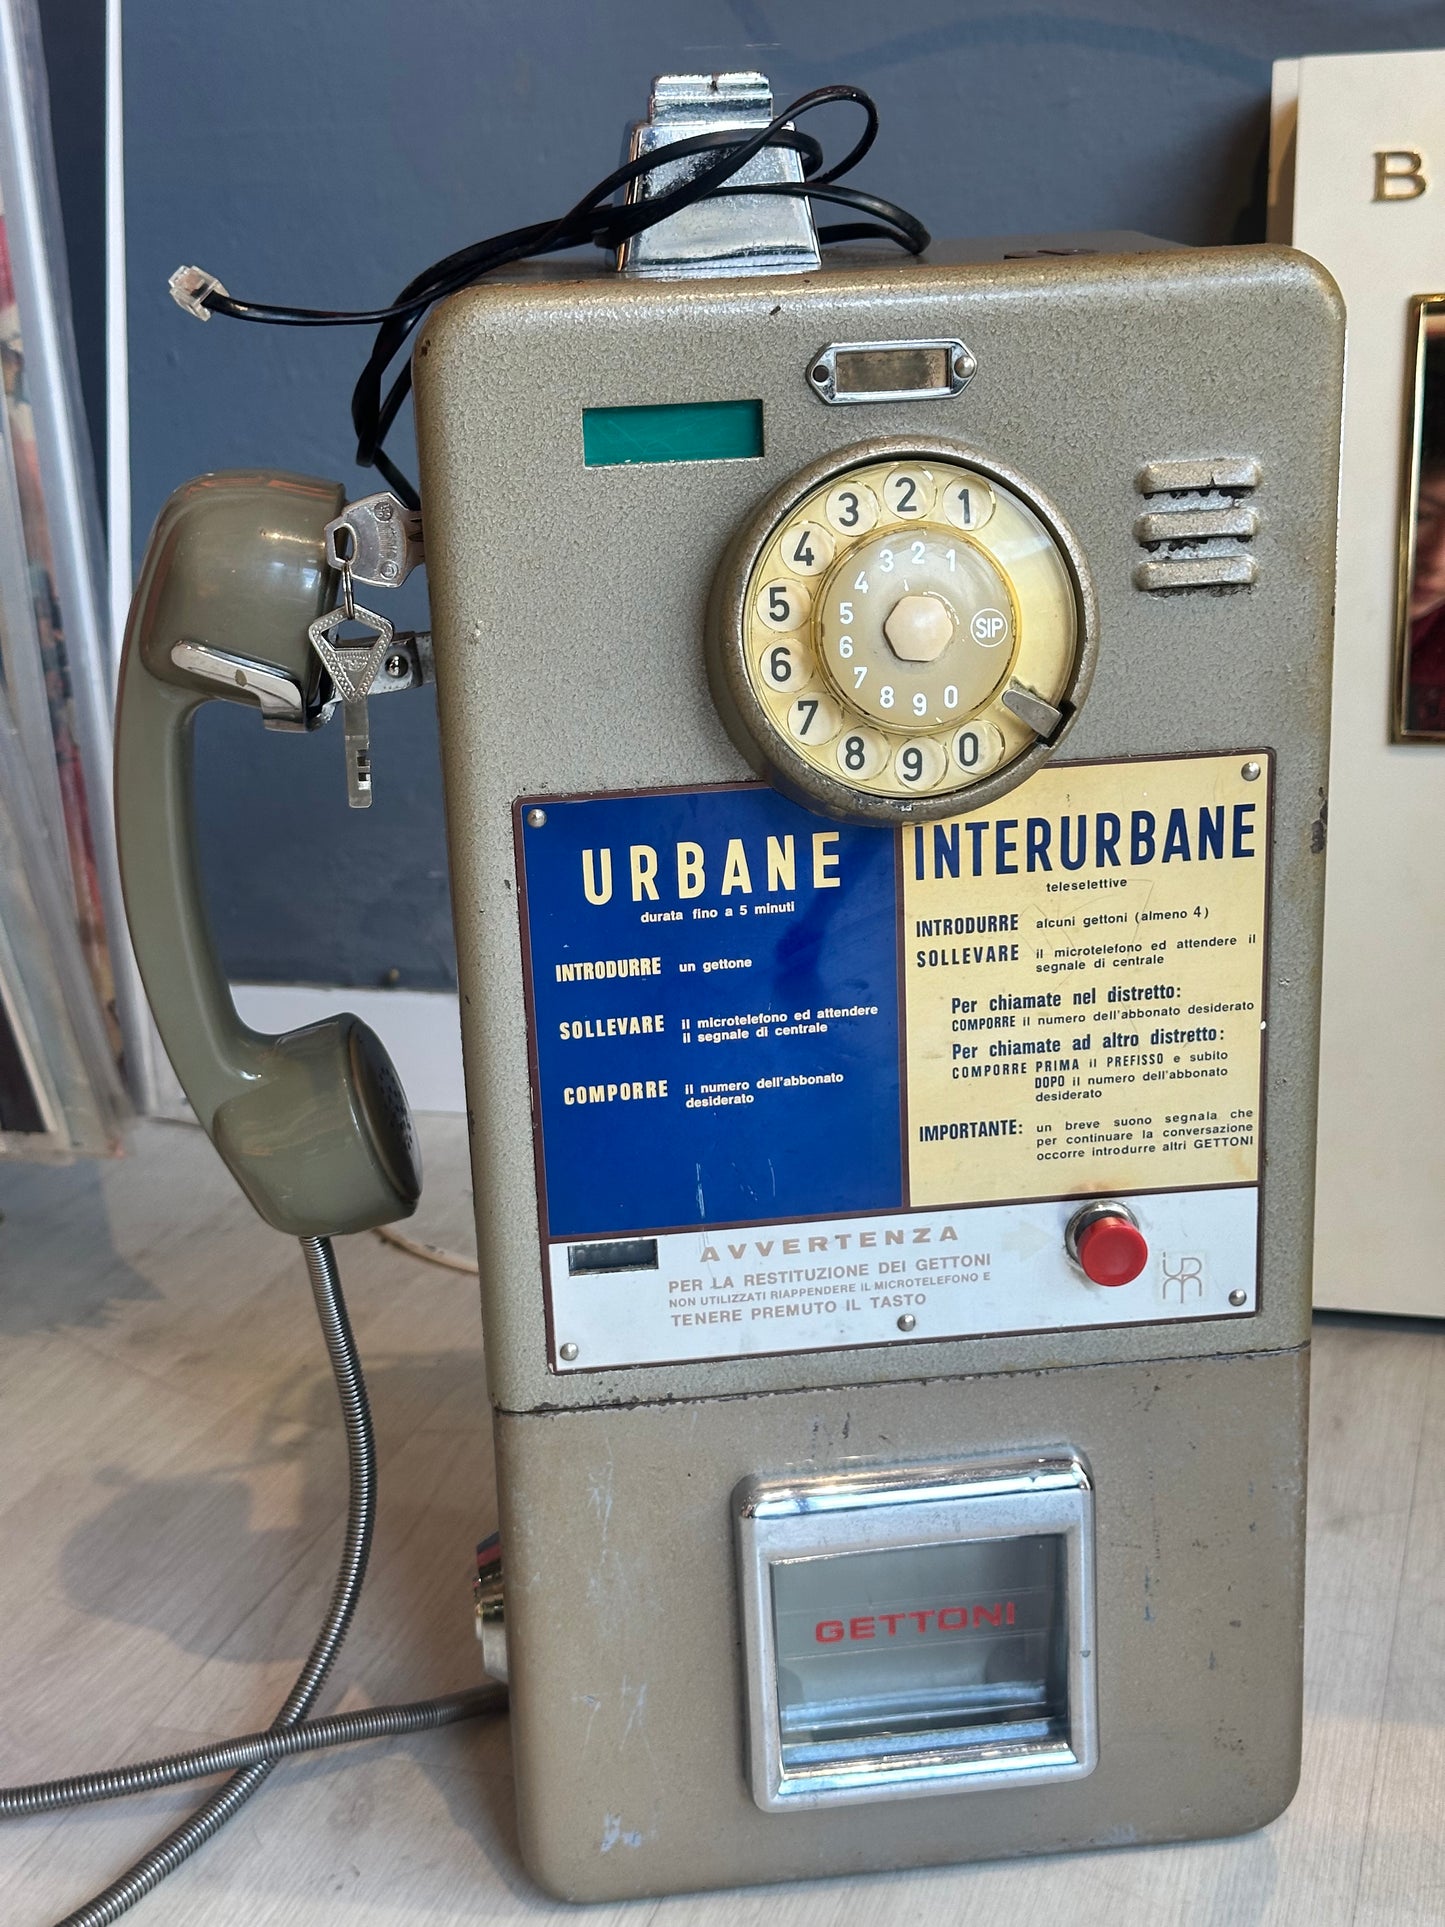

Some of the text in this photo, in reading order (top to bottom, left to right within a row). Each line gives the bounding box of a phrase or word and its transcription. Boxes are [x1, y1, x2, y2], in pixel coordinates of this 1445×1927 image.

[836, 492, 859, 527] 3
[895, 477, 917, 512] 2
[957, 488, 971, 524] 1
[793, 530, 815, 566] 4
[880, 549, 894, 573] 3
[911, 541, 925, 564] 2
[945, 549, 957, 572] 1
[854, 571, 869, 593] 4
[769, 587, 790, 622] 5
[839, 602, 853, 625] 5
[976, 618, 1003, 638] SIP
[839, 636, 853, 658] 6
[770, 647, 791, 682] 6
[853, 667, 867, 689] 7
[880, 685, 895, 708] 8
[913, 693, 927, 716] 9
[944, 685, 958, 707] 0
[797, 700, 818, 735] 7
[845, 736, 866, 771] 8
[902, 747, 923, 782] 9
[958, 732, 978, 767] 0
[914, 803, 1257, 881] INTERURBANE
[581, 831, 841, 906] URBANE
[1046, 877, 1128, 892] teleselettive
[640, 901, 795, 923] durata fino a 5 minuti
[916, 913, 1019, 937] INTRODURRE
[1036, 916, 1076, 929] alcuni
[1082, 911, 1128, 928] gettoni
[1135, 908, 1188, 925] (almeno
[916, 934, 1256, 968] SOLLEVARE il microtelefono ed attendere il
[1036, 953, 1165, 974] segnale di centrale
[555, 957, 753, 982] INTRODURRE un gettone
[951, 983, 1181, 1015] Per chiamate nel distretto:
[559, 1014, 665, 1041] SOLLEVARE
[697, 1010, 788, 1029] microtelefono
[793, 1009, 811, 1022] ed
[816, 1004, 878, 1019] attendere
[951, 1001, 1255, 1032] COMPORRE il numero dell'abbonato desiderato
[697, 1028, 750, 1044] segnale
[755, 1026, 769, 1039] di
[774, 1022, 828, 1036] centrale
[952, 1026, 1225, 1060] Per chiamate ad altro distretto:
[952, 1049, 1229, 1080] COMPORRE PRIMA il PREFISSO e subito
[1034, 1066, 1228, 1089] DOPO il numero dell'abbonato
[563, 1079, 668, 1106] COMPORRE
[700, 1080, 750, 1093] numero
[756, 1071, 844, 1090] dell'abbonato
[685, 1093, 754, 1109] desiderato
[1035, 1088, 1103, 1103] desiderato
[919, 1108, 1254, 1142] IMPORTANTE: un breve suono segnala che
[1036, 1122, 1254, 1148] per continuare la conversazione
[1036, 1136, 1254, 1161] occorre introdurre altri GETTONI
[700, 1226, 959, 1263] AVVERTENZA
[668, 1253, 992, 1294] PER LA RESTITUZIONE DEI GETTONI
[669, 1272, 991, 1308] NON UTILIZZATI RIAPPENDERE IL MICROTELEFONO E
[671, 1293, 927, 1327] TENERE PREMUTO IL TASTO
[815, 1601, 1016, 1644] GETTONI
